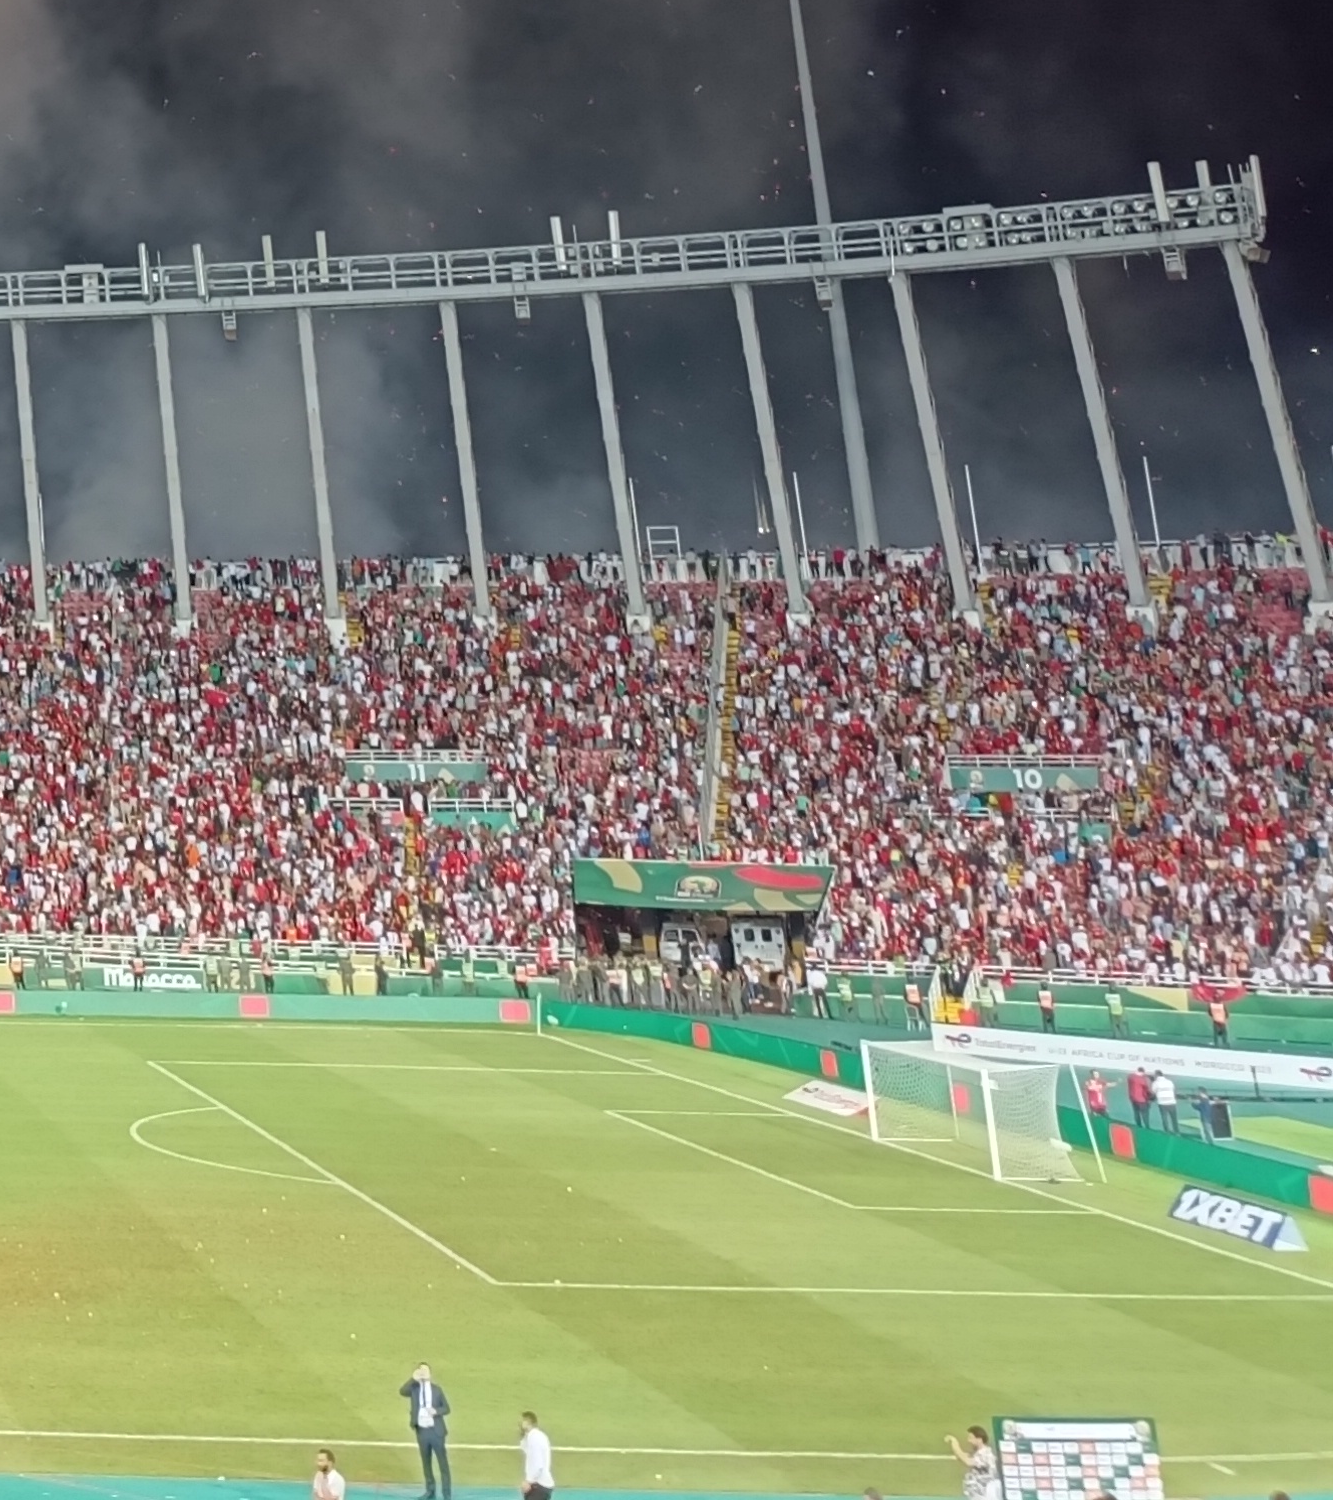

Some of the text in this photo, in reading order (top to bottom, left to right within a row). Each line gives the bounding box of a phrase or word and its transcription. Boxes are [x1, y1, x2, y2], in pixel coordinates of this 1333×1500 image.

[407, 763, 426, 783] 11
[1013, 768, 1043, 790] 10
[1173, 1188, 1284, 1244] 1XBET
